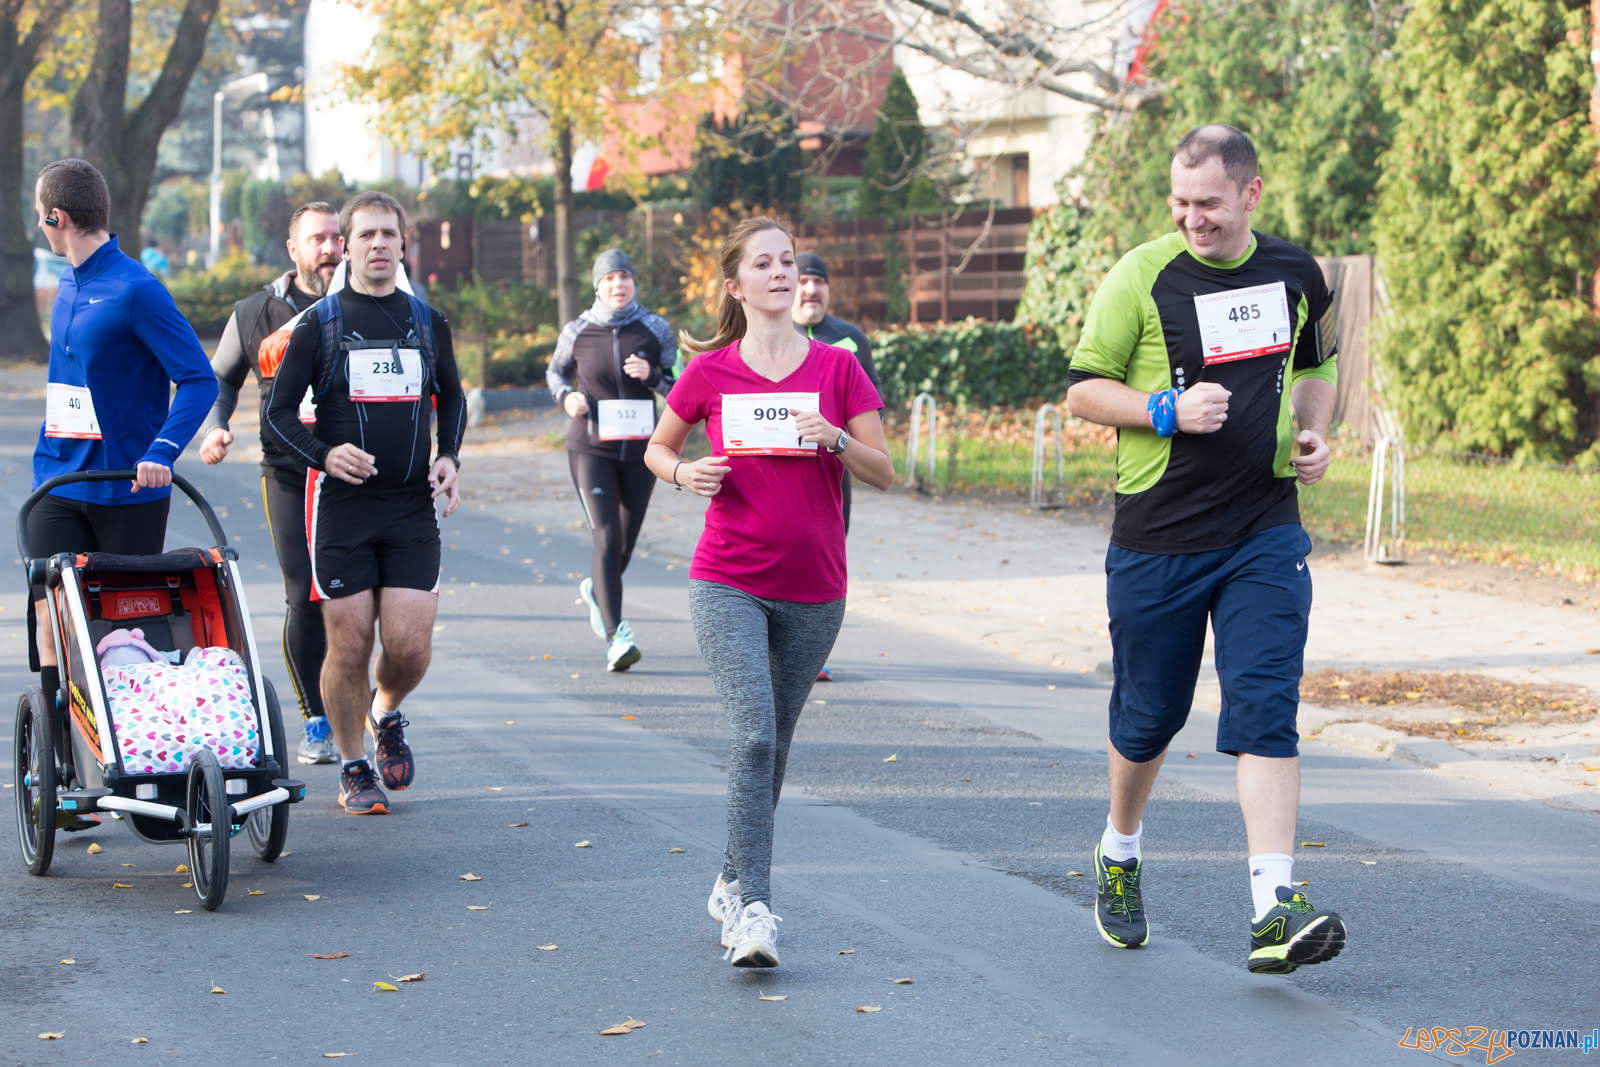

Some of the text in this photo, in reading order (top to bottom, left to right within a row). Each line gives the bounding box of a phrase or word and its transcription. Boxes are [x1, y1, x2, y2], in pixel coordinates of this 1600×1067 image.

[1228, 303, 1261, 322] 485
[372, 361, 398, 374] 238
[68, 397, 81, 410] 40
[753, 407, 789, 421] 909
